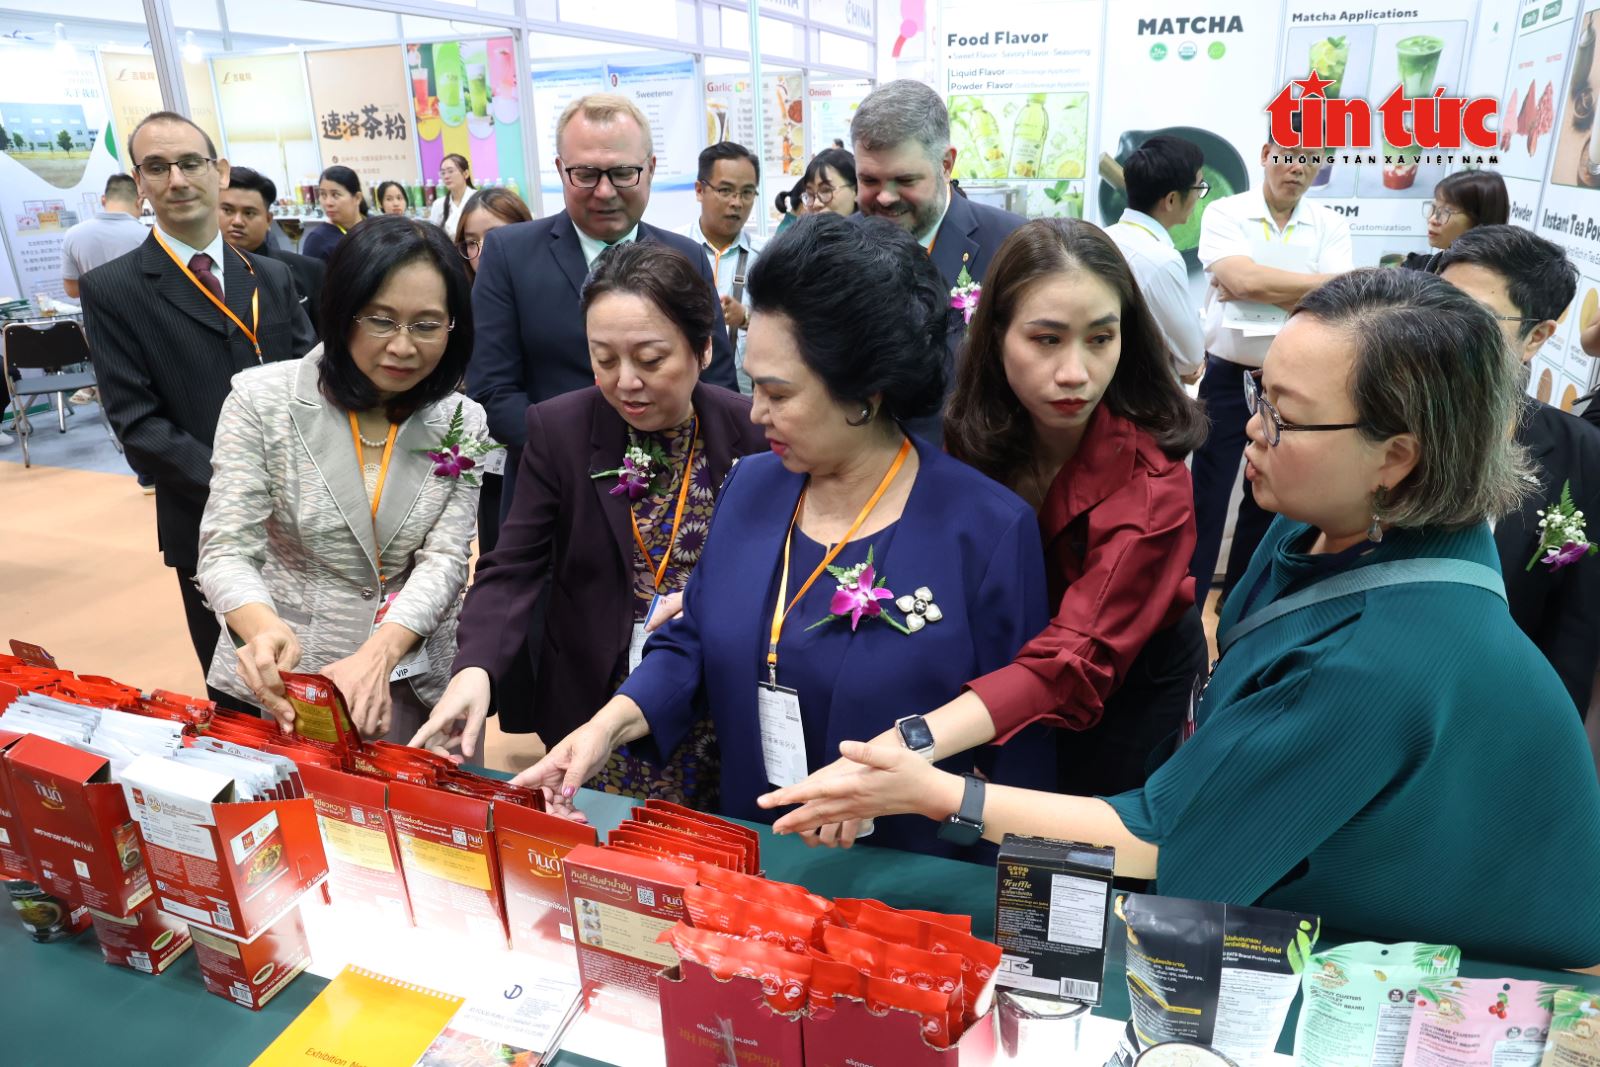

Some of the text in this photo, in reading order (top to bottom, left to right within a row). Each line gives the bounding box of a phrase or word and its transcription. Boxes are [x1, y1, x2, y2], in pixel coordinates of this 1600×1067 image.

[1292, 8, 1418, 22] Matcha Applications
[1138, 15, 1244, 36] MATCHA
[947, 31, 1049, 47] Food Flavor
[951, 69, 977, 79] Liquid
[979, 67, 1005, 76] Flavor
[706, 82, 732, 93] Garlic
[951, 83, 983, 91] Powder
[986, 81, 1013, 90] Flavor
[635, 88, 674, 99] Sweetener
[809, 88, 832, 97] Onion
[321, 104, 407, 142] 速溶茶粉
[1323, 204, 1360, 218] DM
[1511, 201, 1533, 223] Powder
[1349, 223, 1412, 232] Customization
[1542, 208, 1569, 235] Instant
[1569, 213, 1585, 238] Tea
[396, 667, 409, 678] VIP
[528, 848, 560, 872] กินดี
[1007, 865, 1029, 873] GOOD
[1003, 879, 1032, 889] Truffle
[662, 893, 683, 905] กินดี
[305, 1047, 347, 1066] Exhibition
